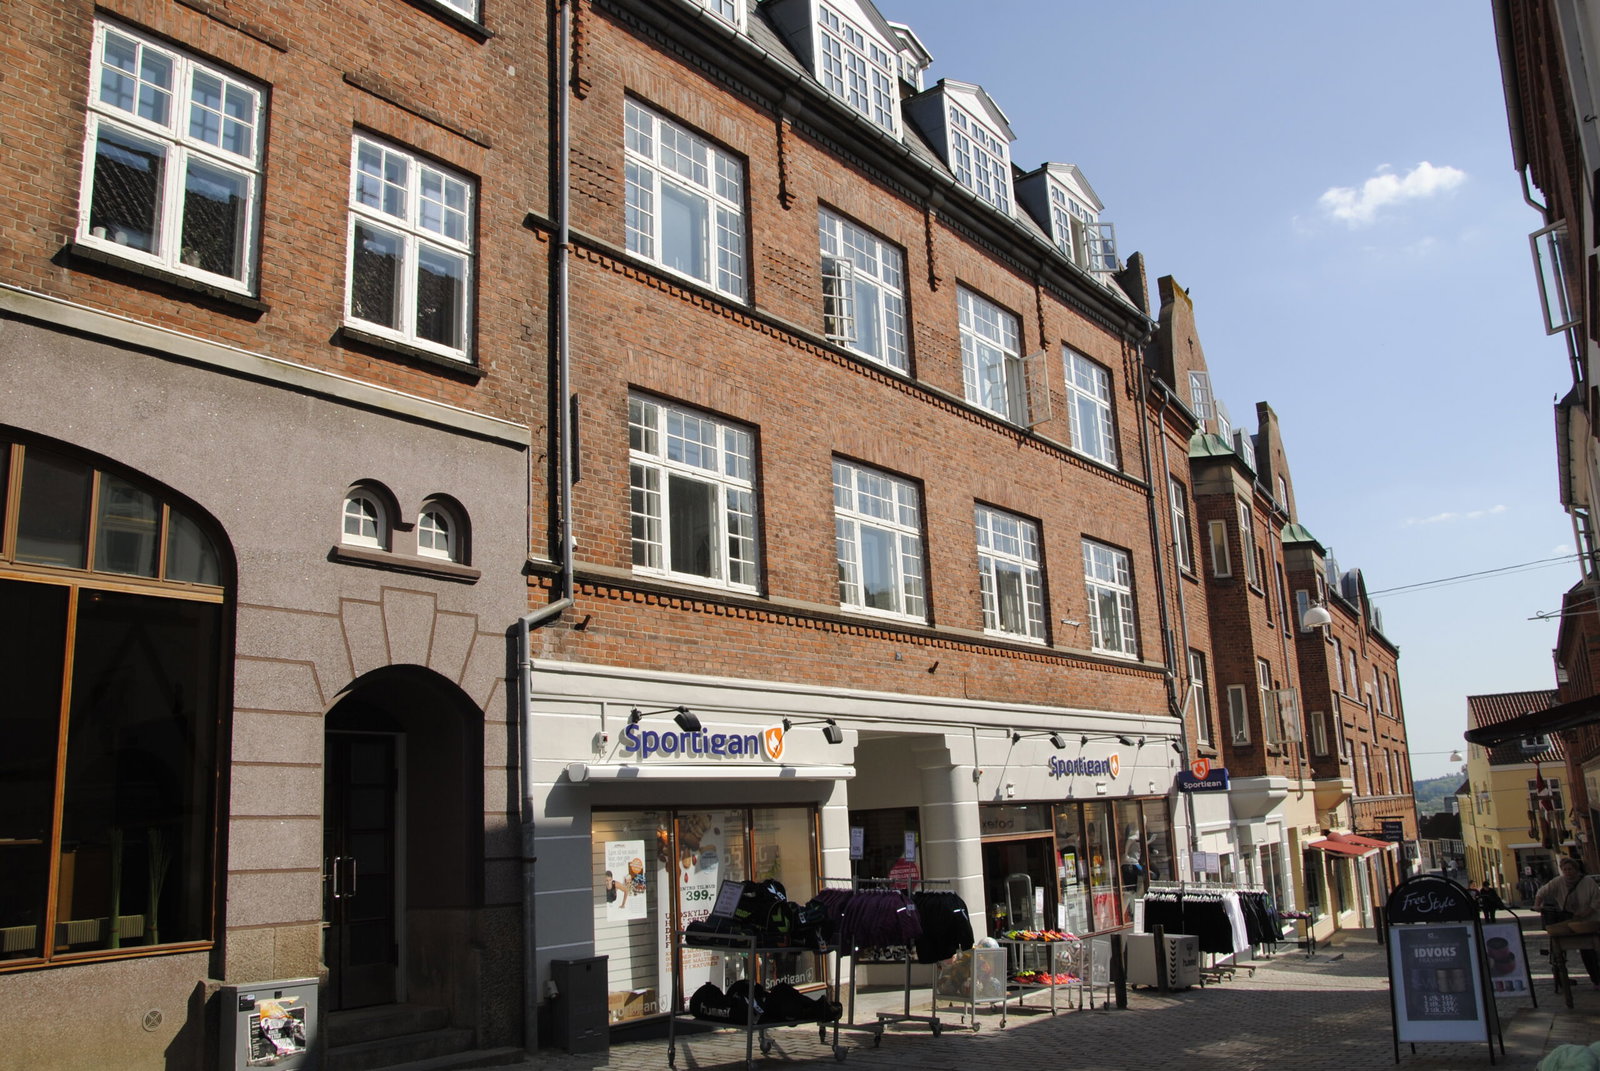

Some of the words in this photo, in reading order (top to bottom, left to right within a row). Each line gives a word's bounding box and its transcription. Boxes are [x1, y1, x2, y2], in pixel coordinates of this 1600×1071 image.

[625, 724, 759, 758] Sportigan
[1051, 755, 1110, 780] Sportigan
[1183, 779, 1222, 789] Sportigan
[686, 889, 715, 901] 399,-
[1414, 947, 1457, 958] IDVOKS
